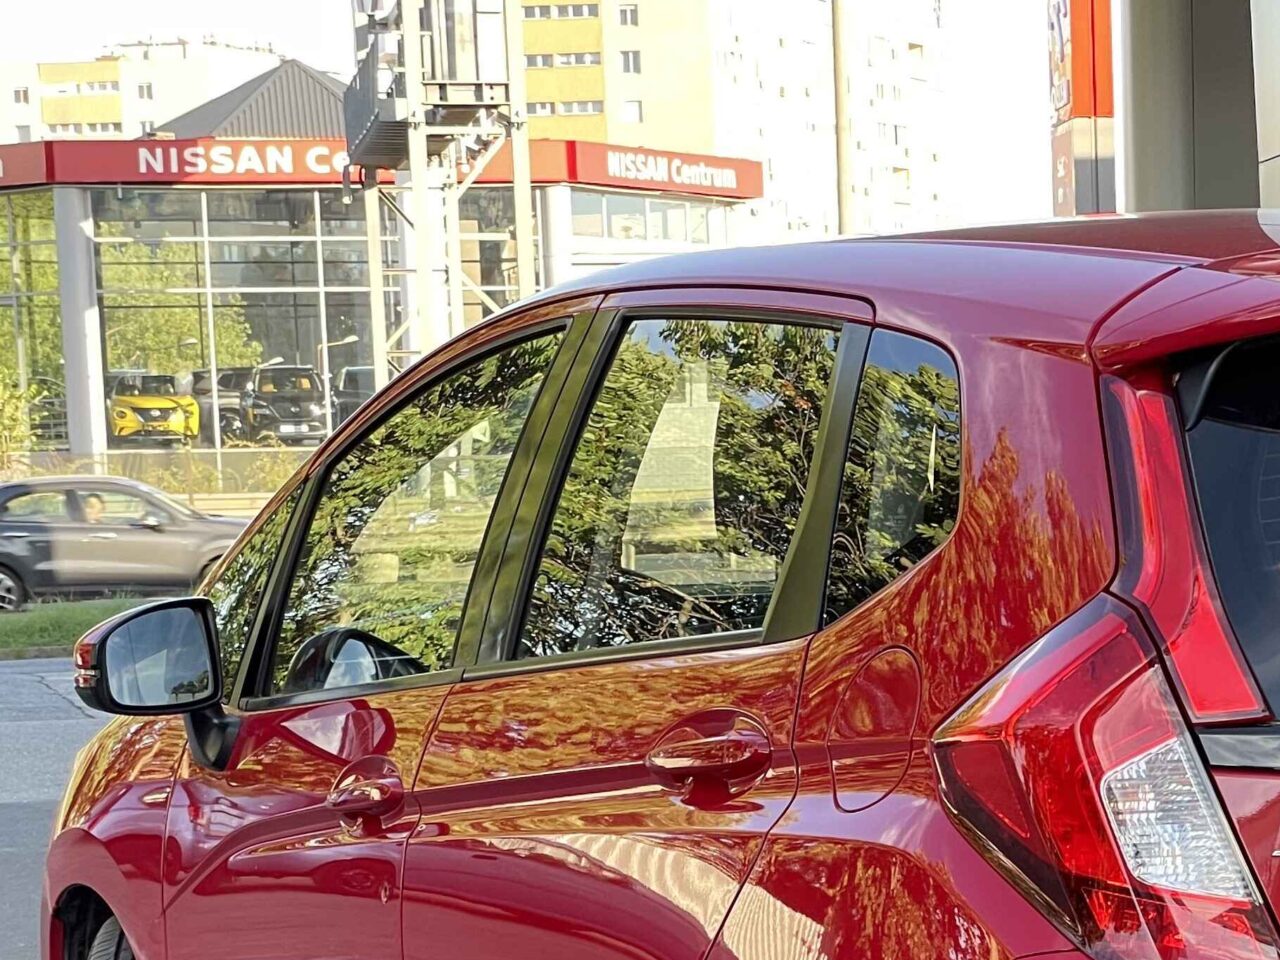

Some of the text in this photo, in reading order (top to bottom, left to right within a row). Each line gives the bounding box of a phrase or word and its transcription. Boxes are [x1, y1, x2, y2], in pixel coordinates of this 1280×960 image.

[138, 147, 294, 174] NISSAN
[607, 151, 737, 189] NISSAN Centrum
